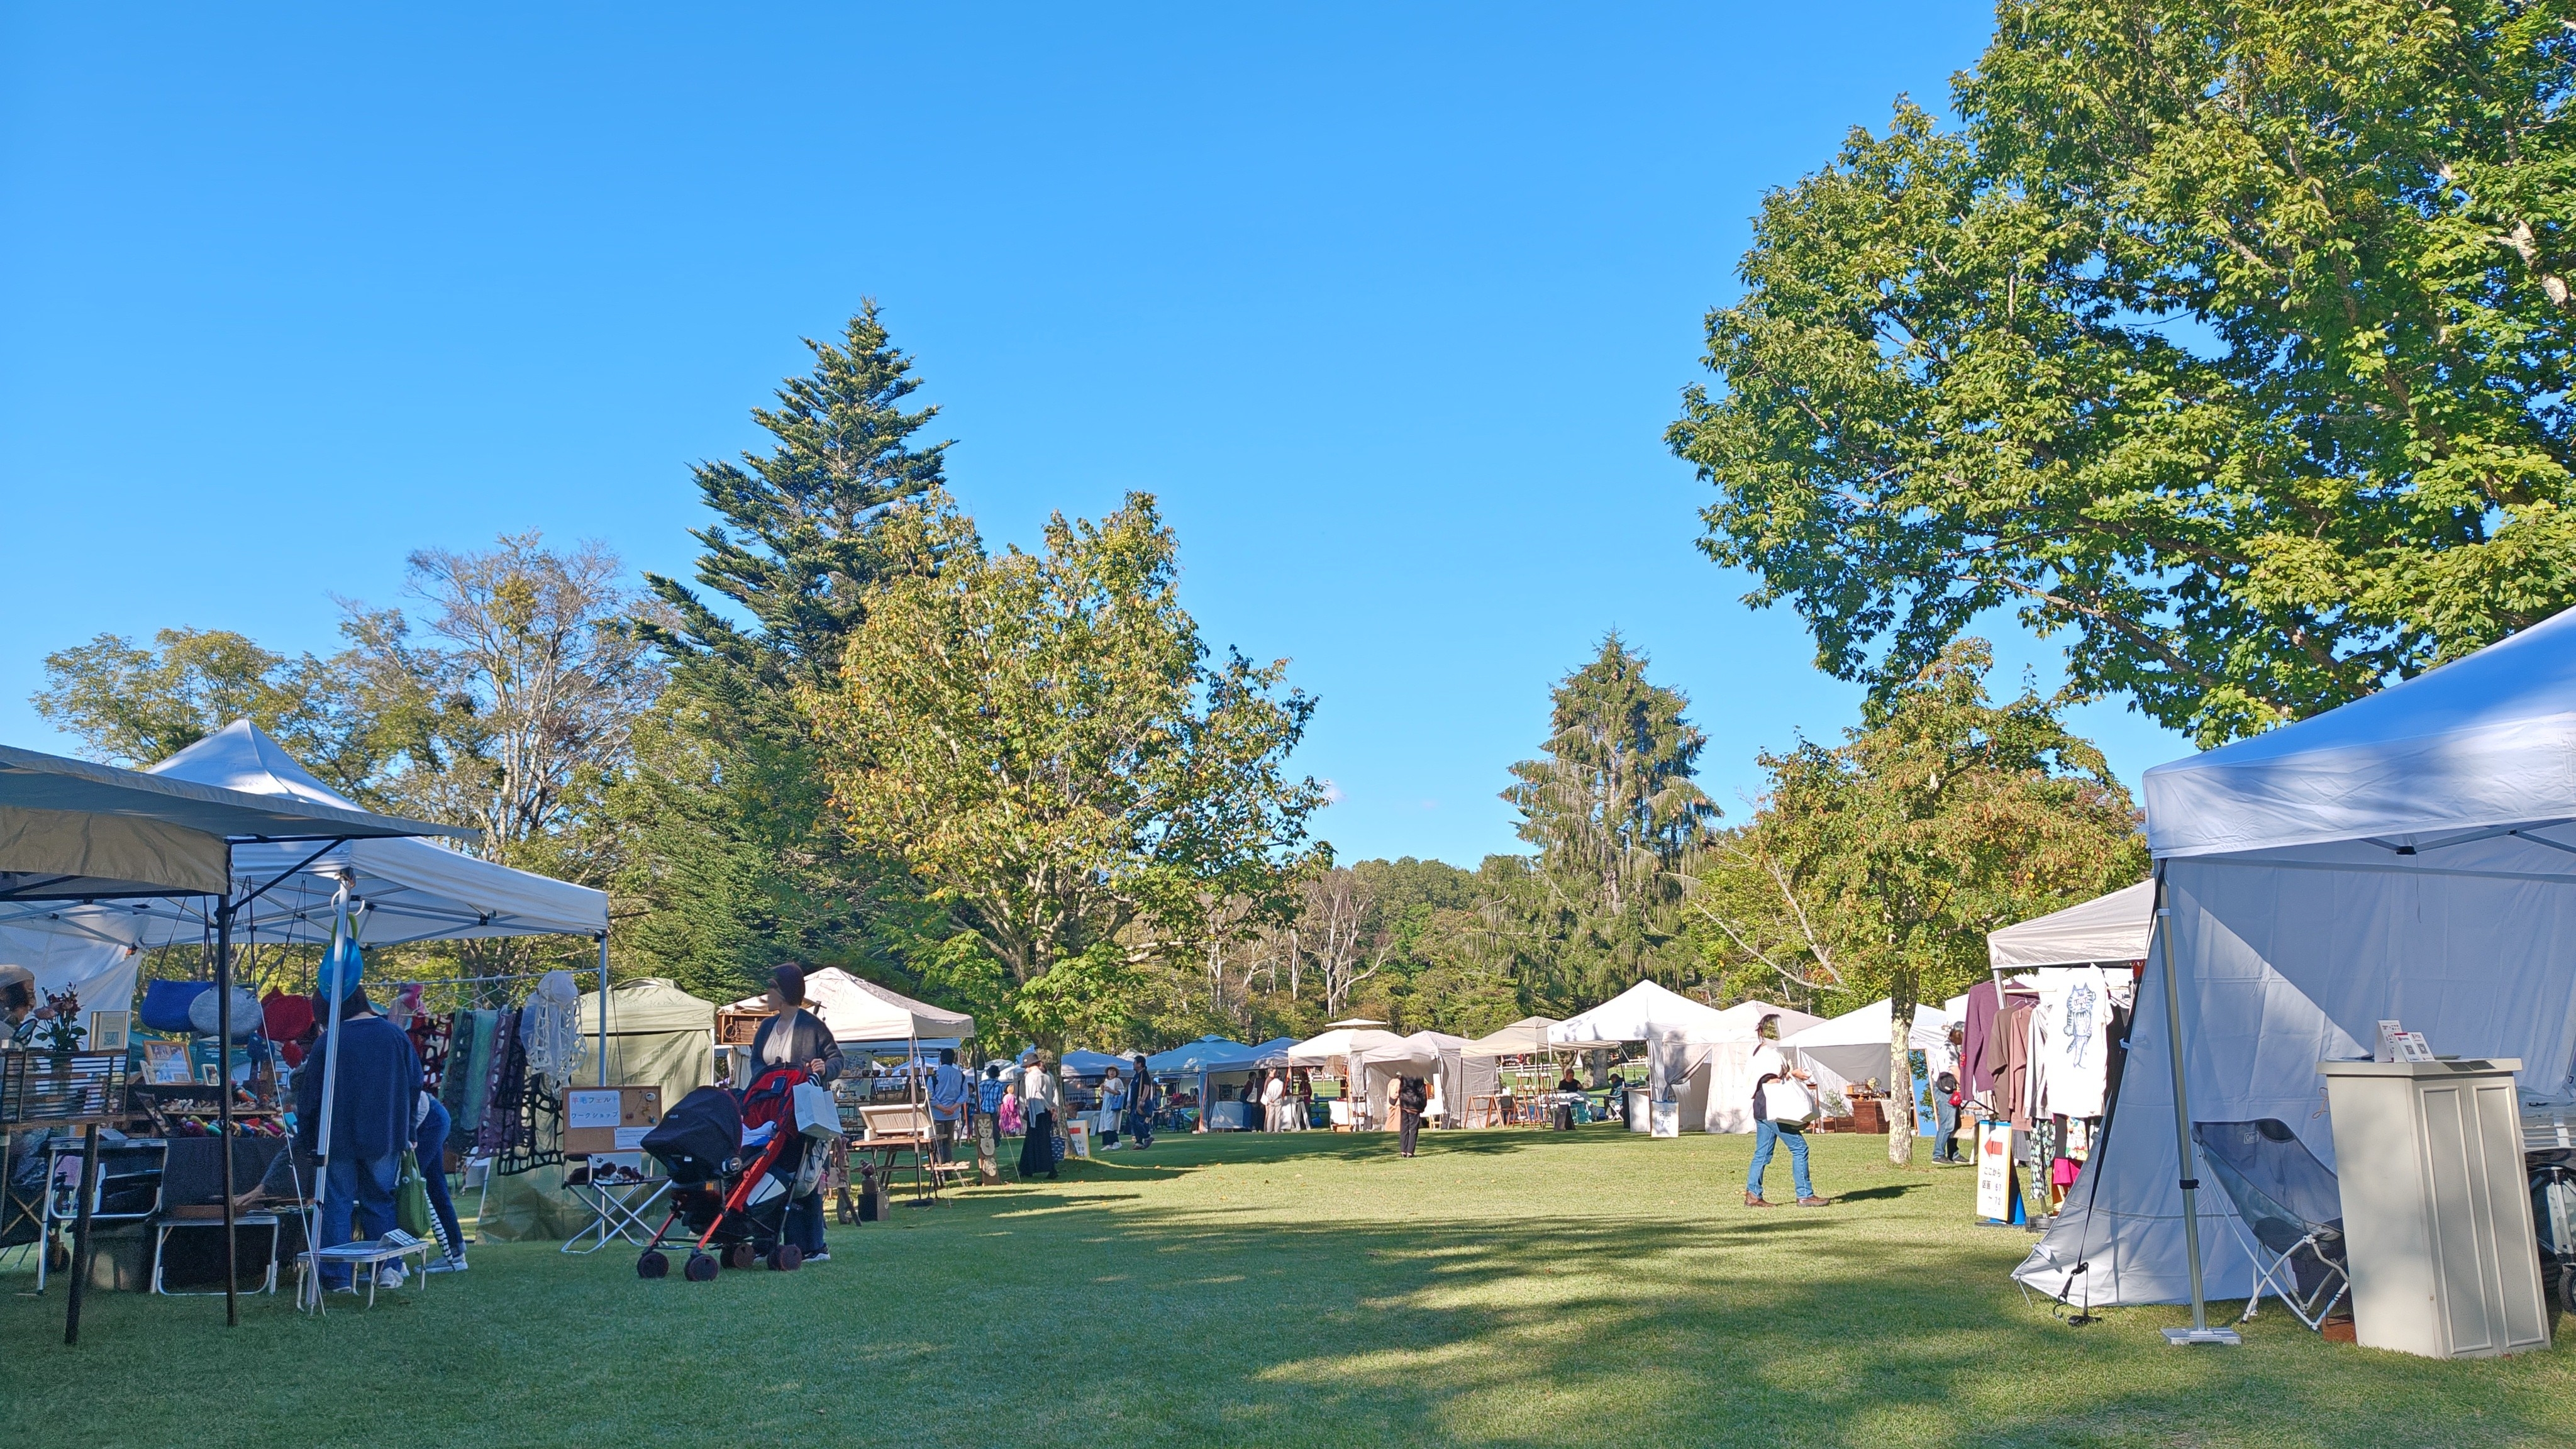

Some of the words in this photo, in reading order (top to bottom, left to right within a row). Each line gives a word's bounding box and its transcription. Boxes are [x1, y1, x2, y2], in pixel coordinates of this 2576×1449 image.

[572, 1096, 618, 1104] 羊毛フェルト
[572, 1111, 618, 1119] ワークショップ
[1984, 1167, 2001, 1178] ここから
